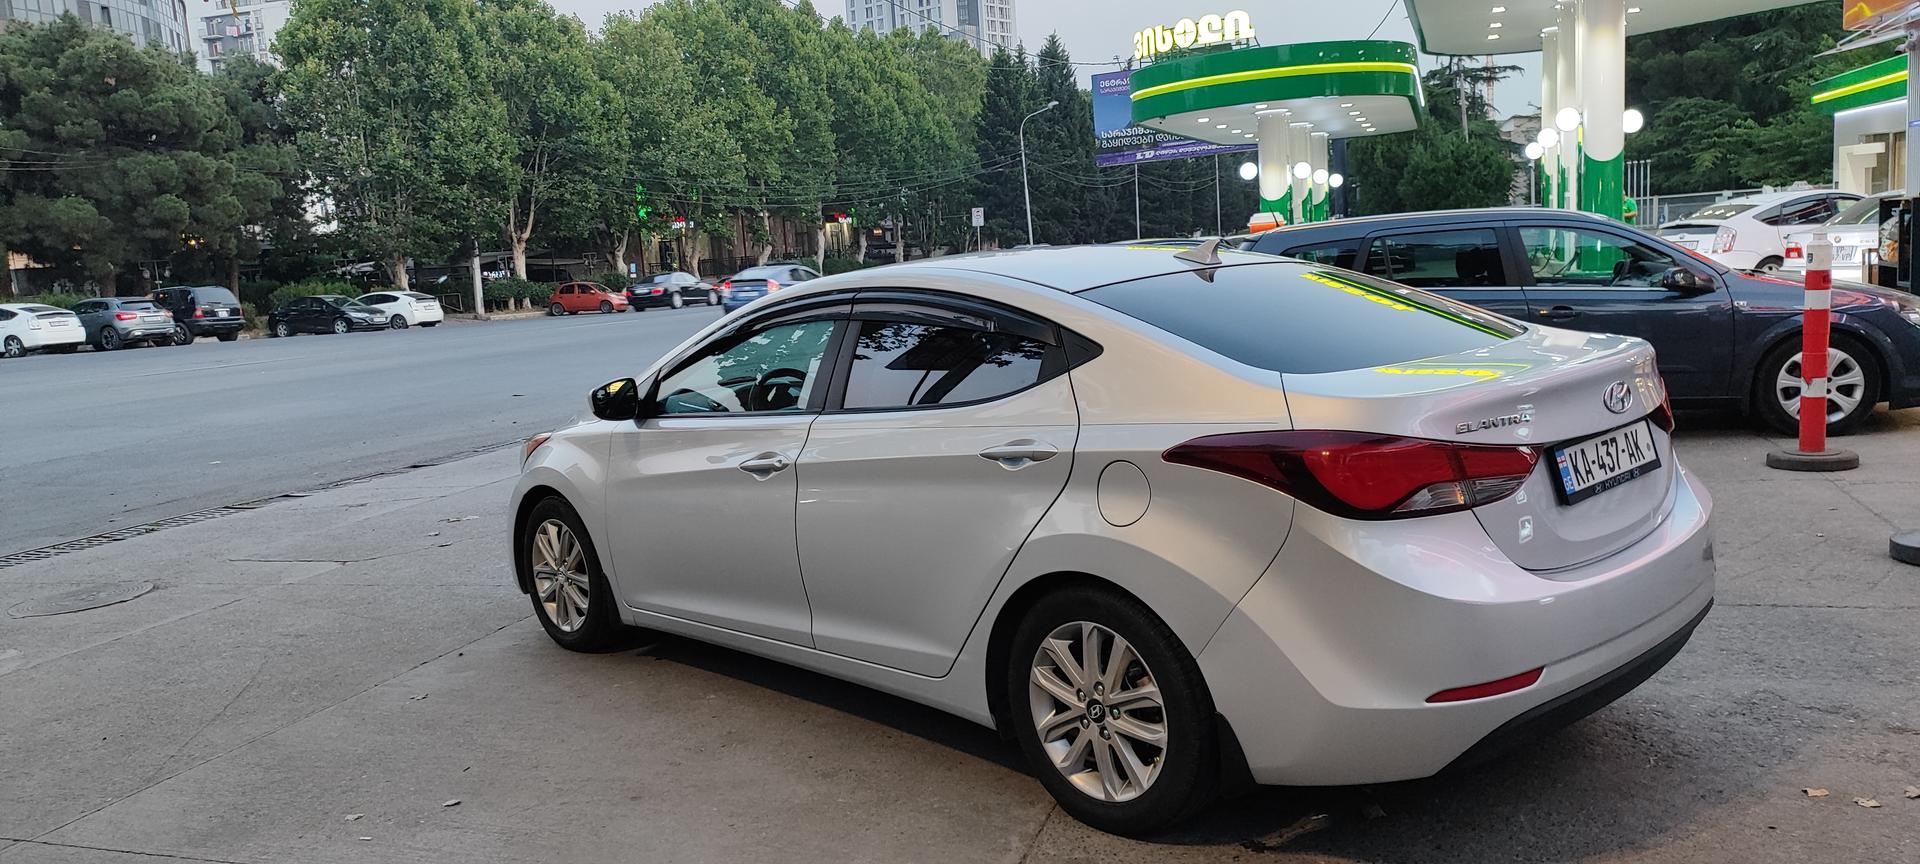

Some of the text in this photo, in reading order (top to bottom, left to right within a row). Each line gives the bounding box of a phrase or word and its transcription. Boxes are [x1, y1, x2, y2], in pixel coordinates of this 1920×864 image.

[1133, 9, 1256, 60] ვისოლი
[1101, 135, 1154, 149] გაყიდვები
[1456, 412, 1531, 435] ELANTRA
[1569, 428, 1646, 487] KA-437-AK
[1604, 472, 1631, 489] HYUNDAI
